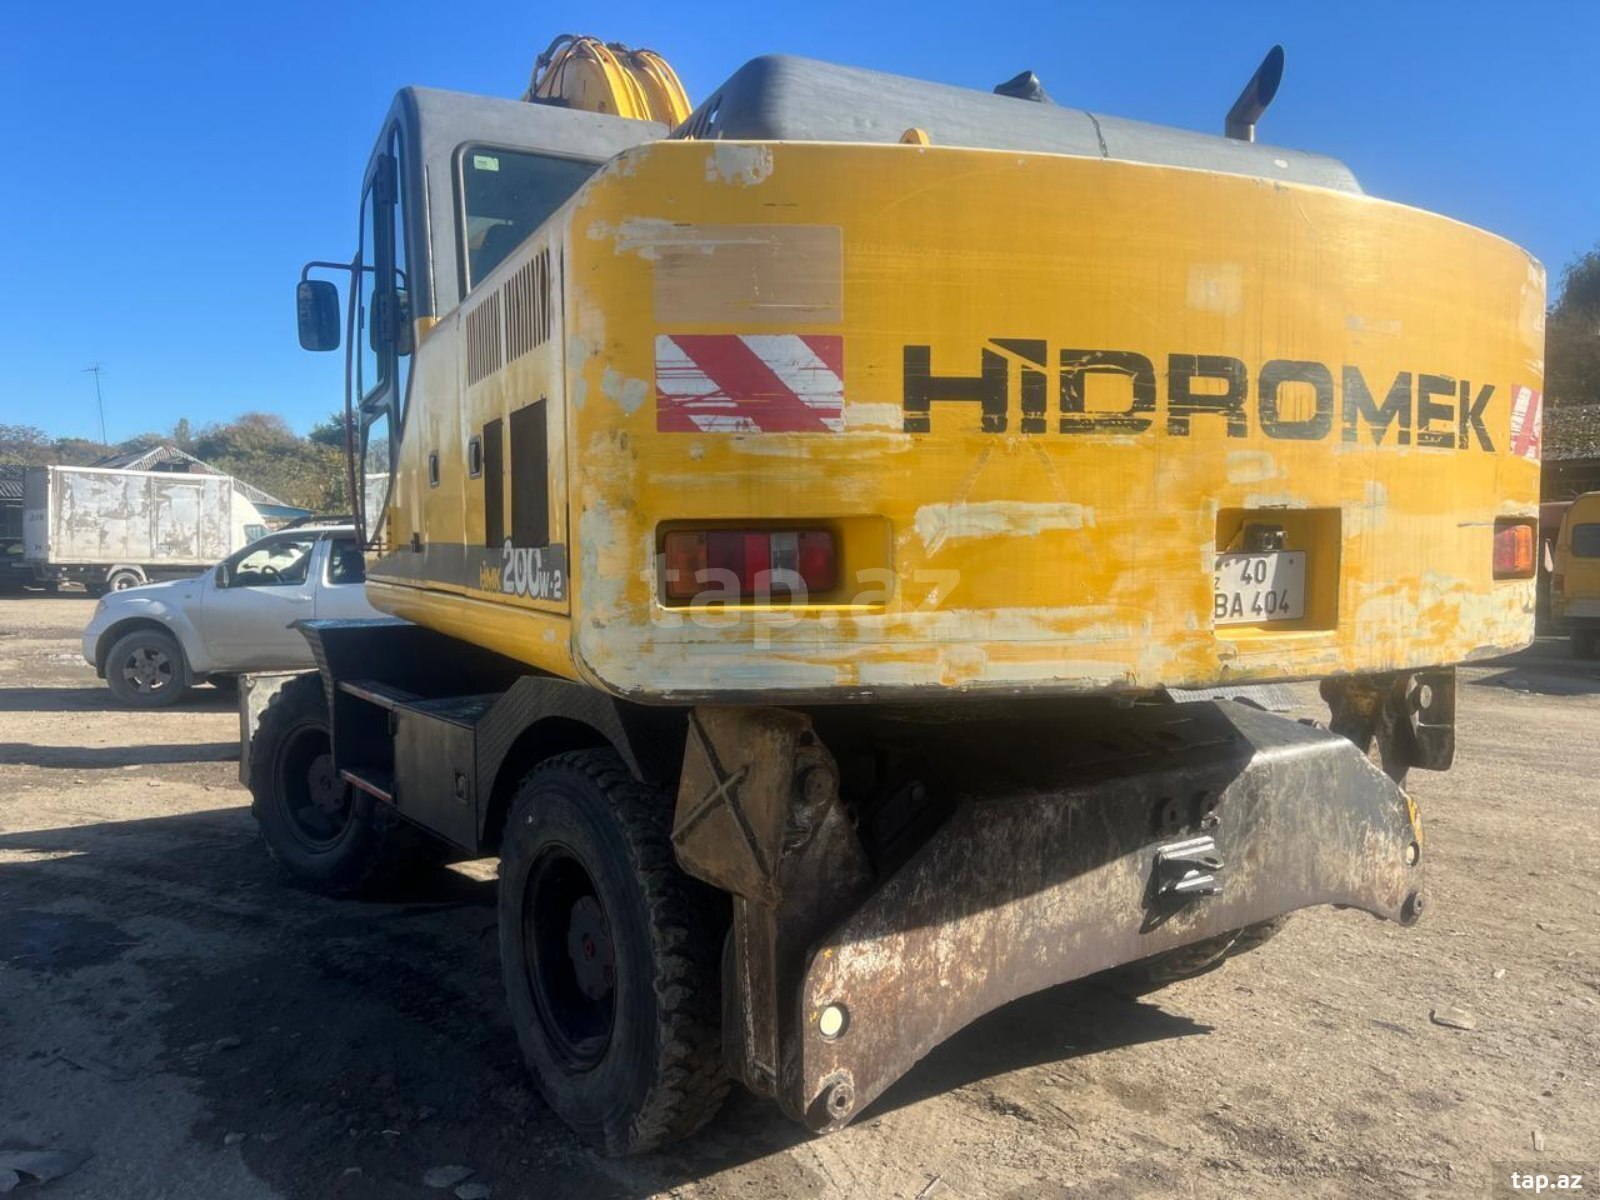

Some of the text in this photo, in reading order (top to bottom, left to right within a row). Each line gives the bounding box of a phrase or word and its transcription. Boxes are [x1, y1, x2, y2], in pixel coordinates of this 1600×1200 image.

[1240, 559, 1267, 584] 40
[1214, 589, 1290, 618] BA 404
